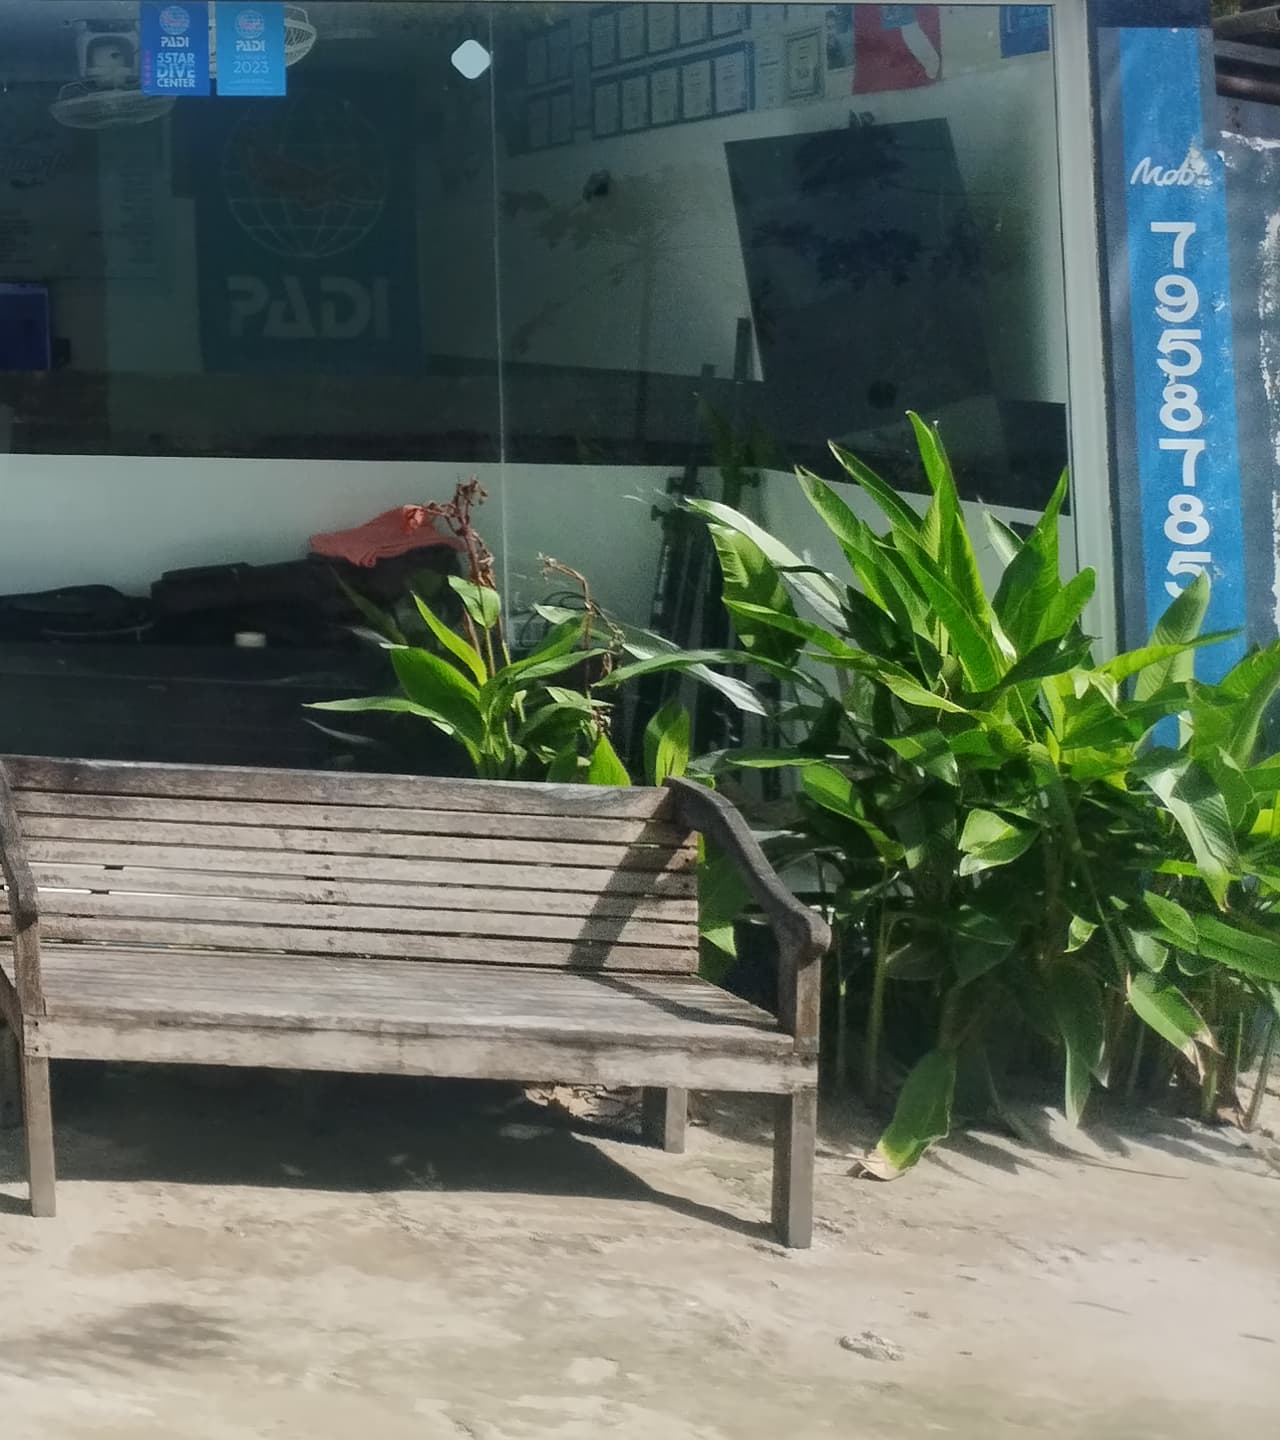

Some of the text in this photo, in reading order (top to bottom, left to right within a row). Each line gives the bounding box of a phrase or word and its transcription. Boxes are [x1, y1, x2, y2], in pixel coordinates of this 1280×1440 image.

[161, 36, 189, 48] PADI
[236, 40, 265, 52] PADI
[157, 64, 195, 78] DIVE
[233, 60, 269, 74] 2023
[157, 79, 196, 89] CENTER
[226, 275, 372, 340] PADI
[1149, 221, 1212, 600] 7958785
